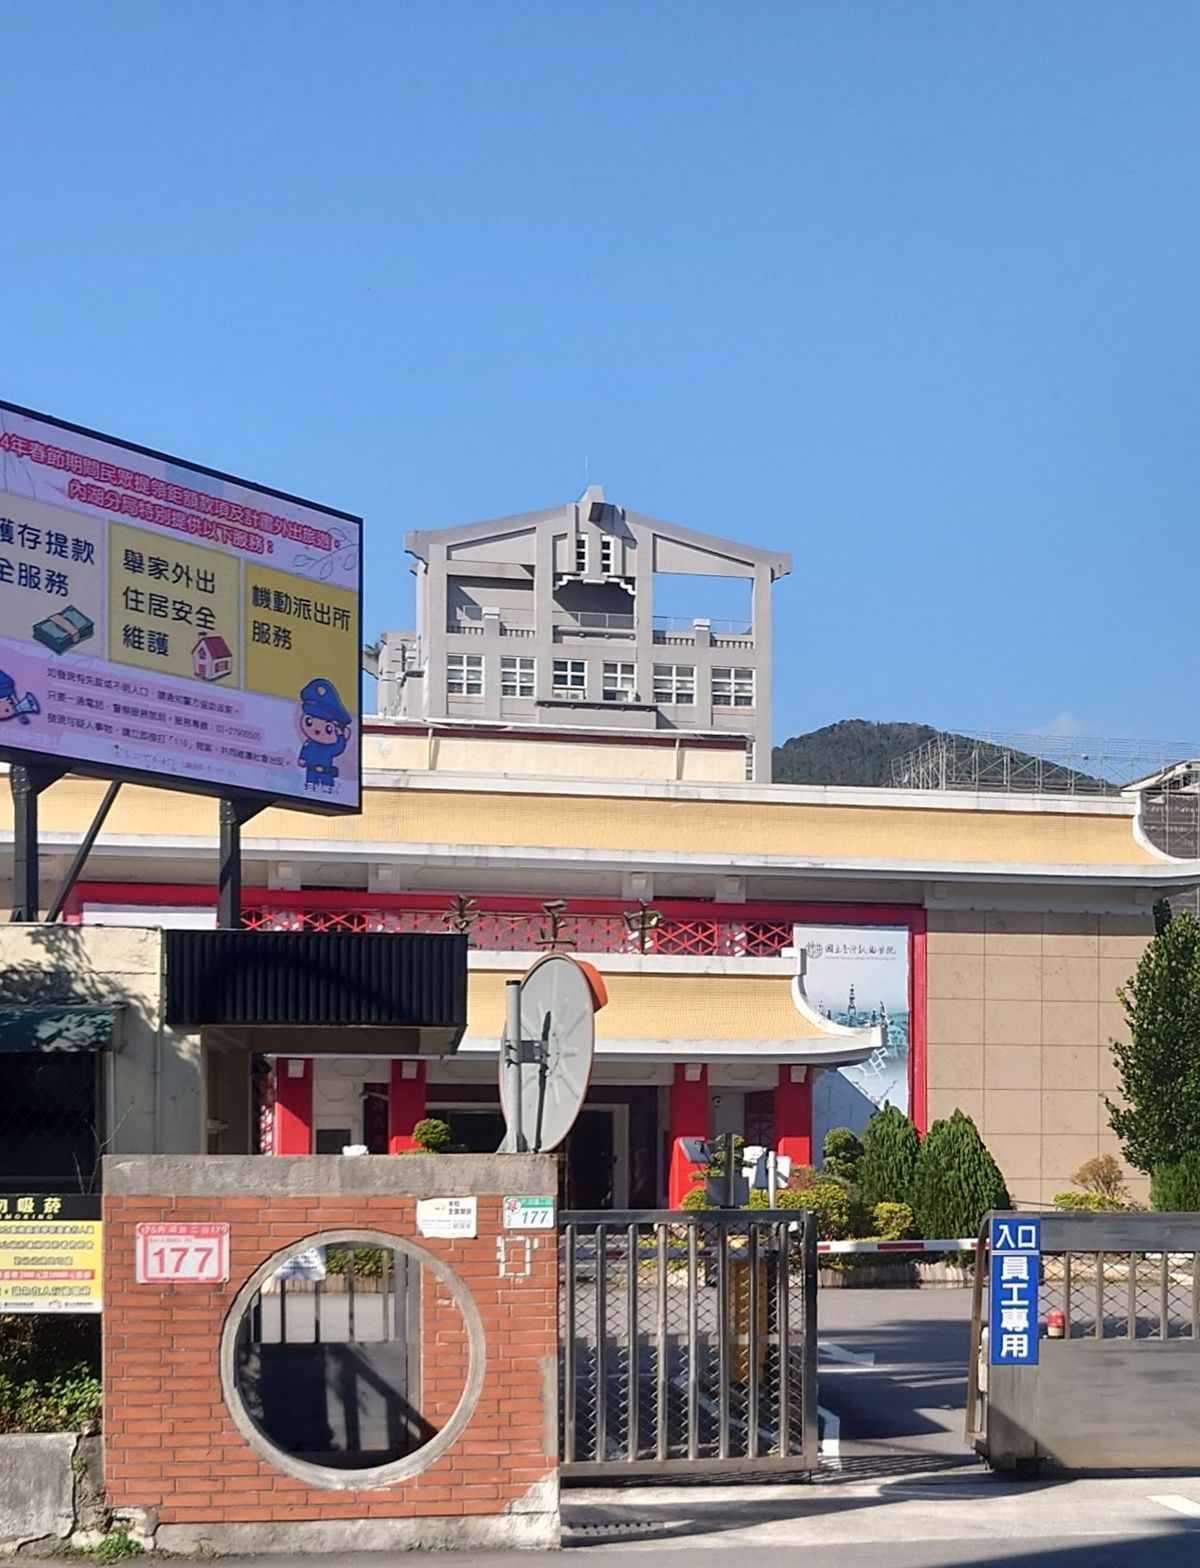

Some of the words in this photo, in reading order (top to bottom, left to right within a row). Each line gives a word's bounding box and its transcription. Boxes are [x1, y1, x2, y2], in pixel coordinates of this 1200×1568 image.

[122, 549, 216, 594] 舉家外出
[122, 586, 216, 631] 住居安全
[252, 584, 351, 632] 機動派出所
[122, 623, 169, 657] 維護
[252, 620, 292, 650] 服務
[523, 1210, 548, 1225] 177
[996, 1225, 1036, 1249] 入口
[153, 1247, 213, 1273] 177
[1001, 1256, 1029, 1358] 員工專用
